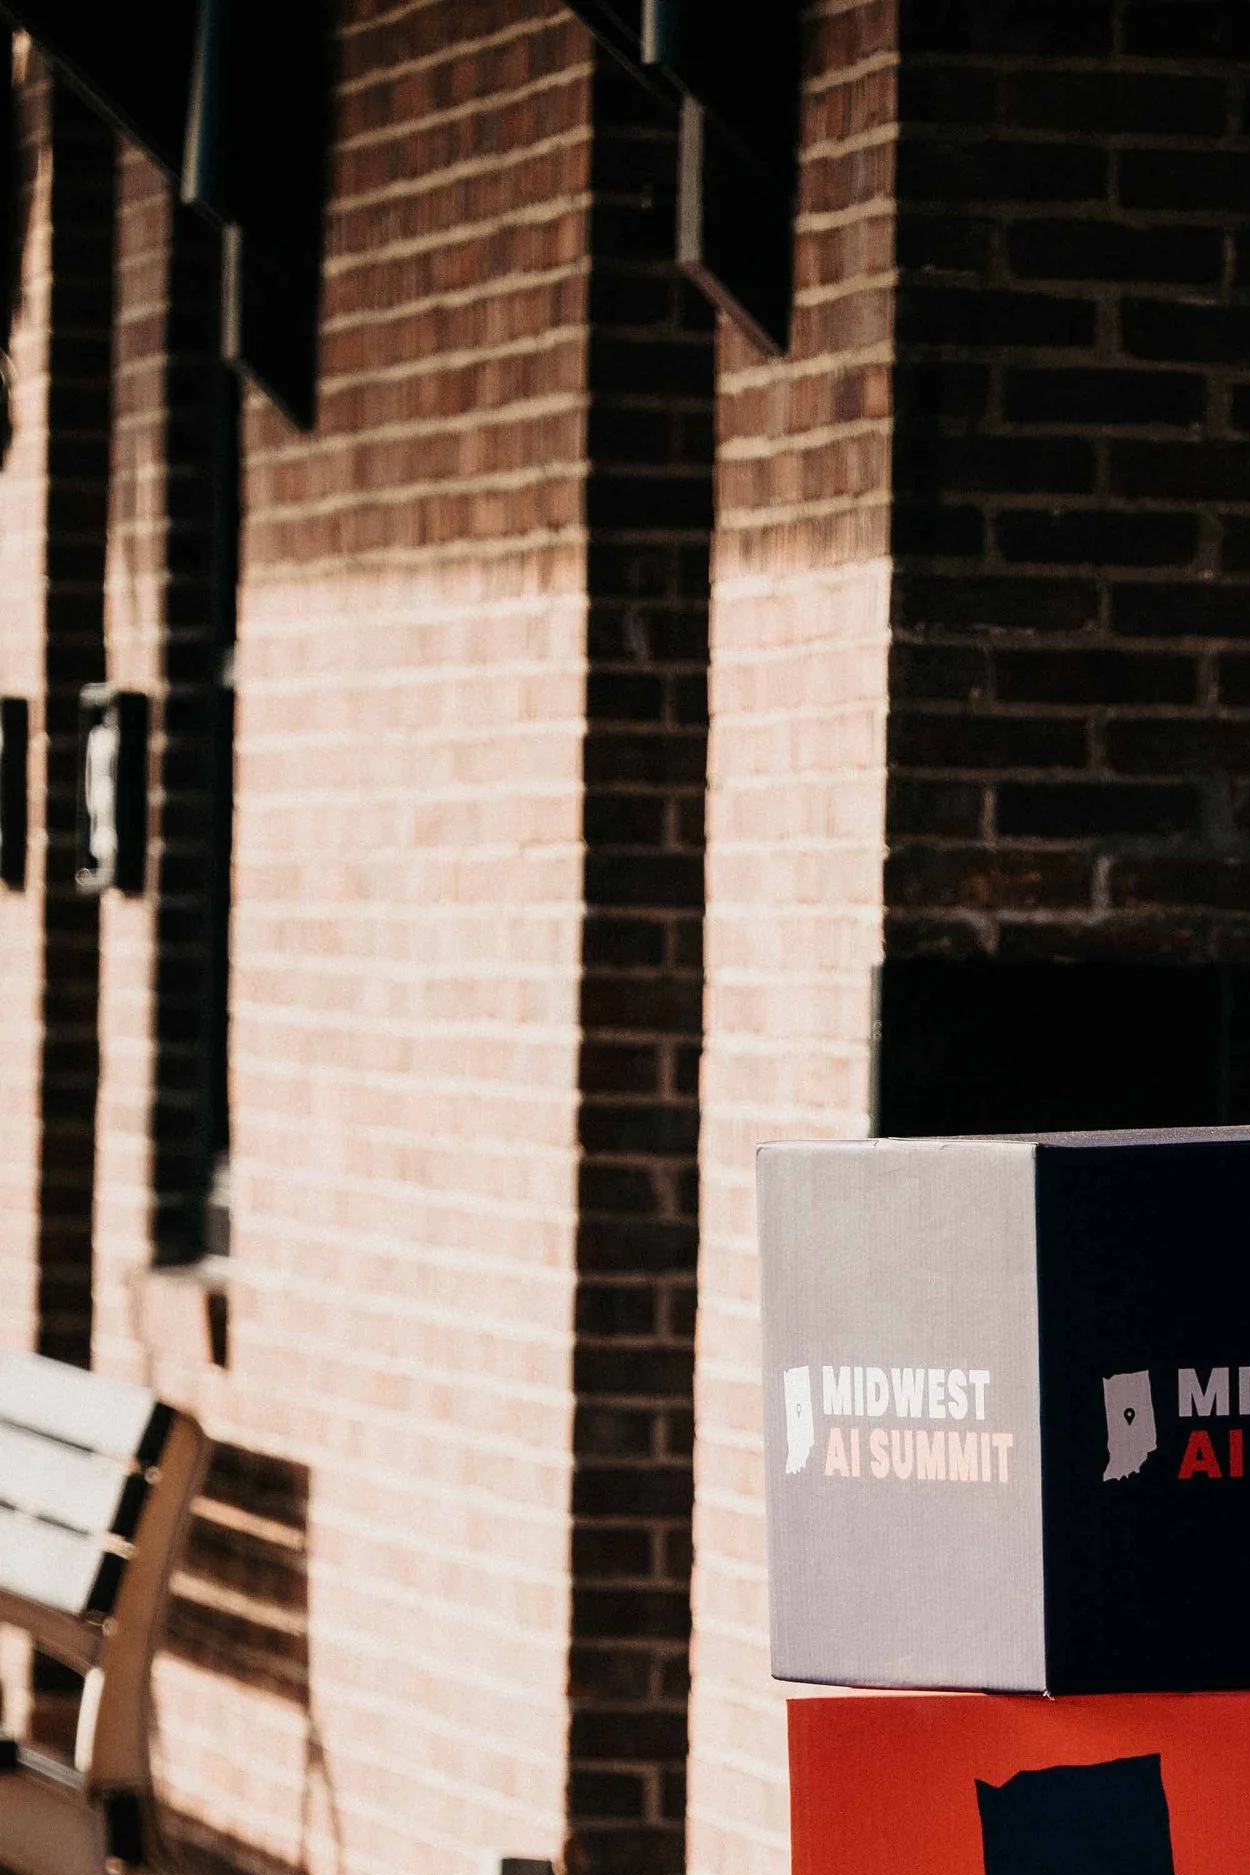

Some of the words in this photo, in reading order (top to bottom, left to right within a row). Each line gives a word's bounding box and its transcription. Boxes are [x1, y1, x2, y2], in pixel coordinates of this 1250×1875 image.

[822, 1365, 990, 1420] MIDWEST
[824, 1427, 860, 1477] AI
[870, 1428, 1013, 1483] SUMMIT
[1178, 1429, 1244, 1479] AI
